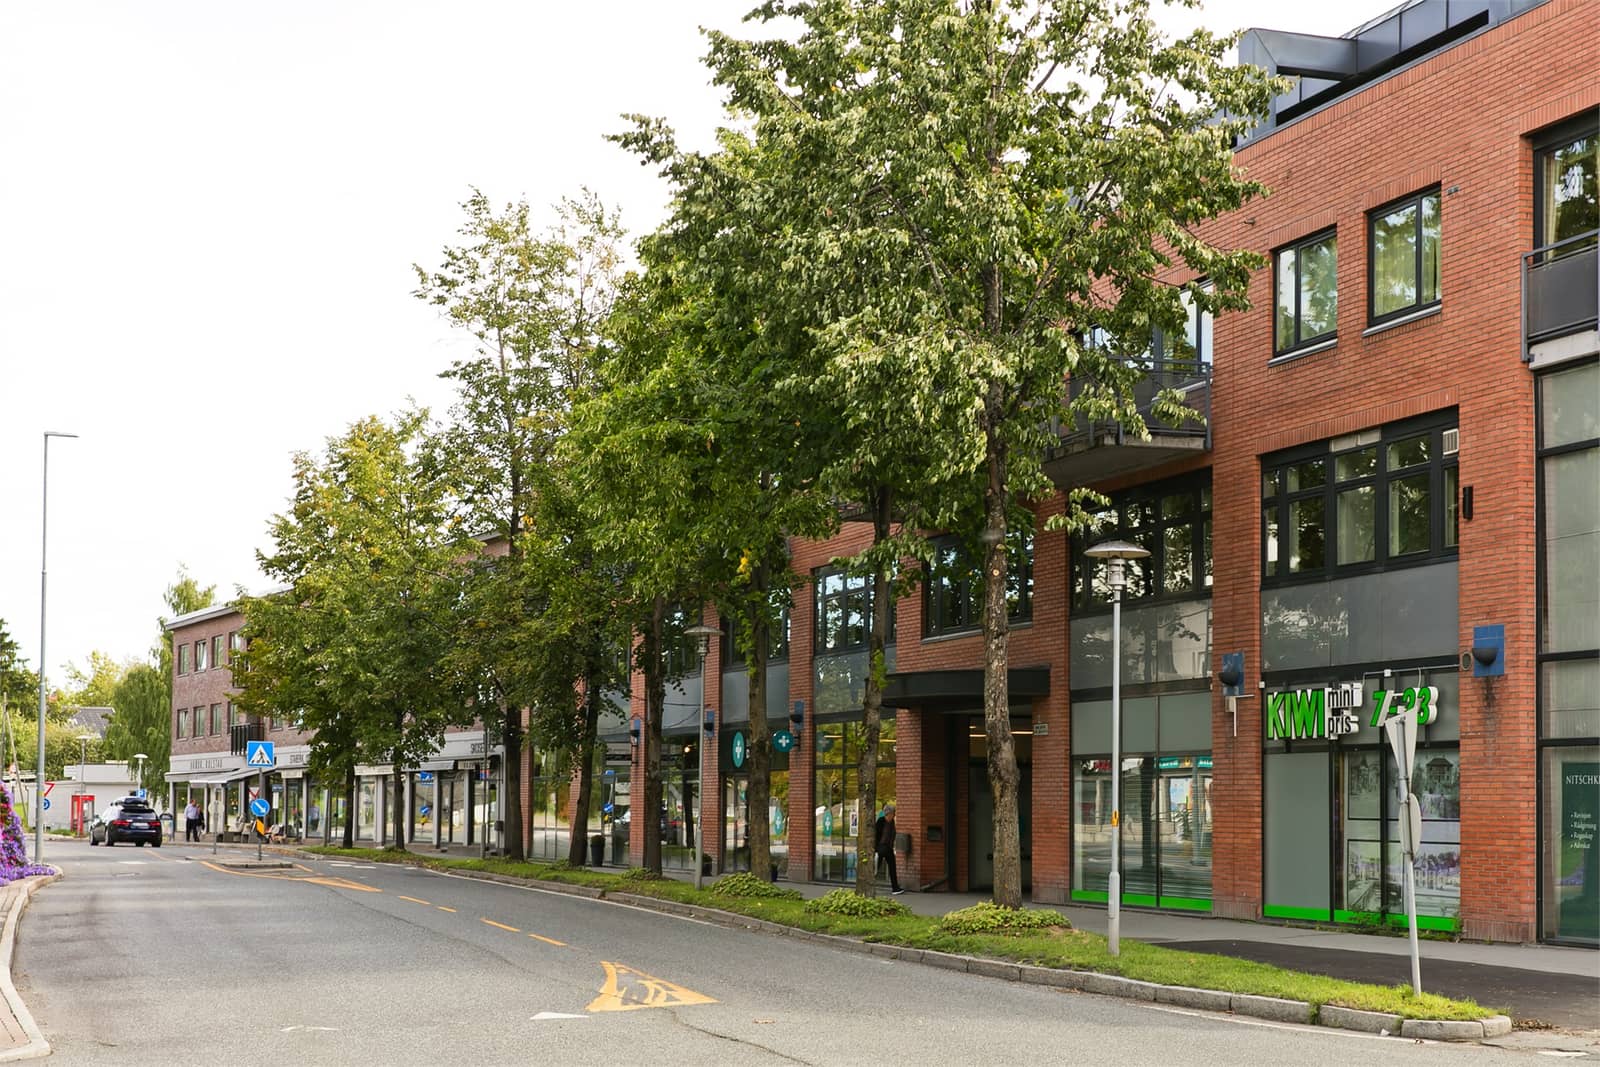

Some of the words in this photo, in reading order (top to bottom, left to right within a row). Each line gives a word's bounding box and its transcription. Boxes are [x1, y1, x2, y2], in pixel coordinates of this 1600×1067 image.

[1328, 686, 1355, 708] mini
[1267, 688, 1325, 739] KIWI
[1328, 713, 1352, 735] pris
